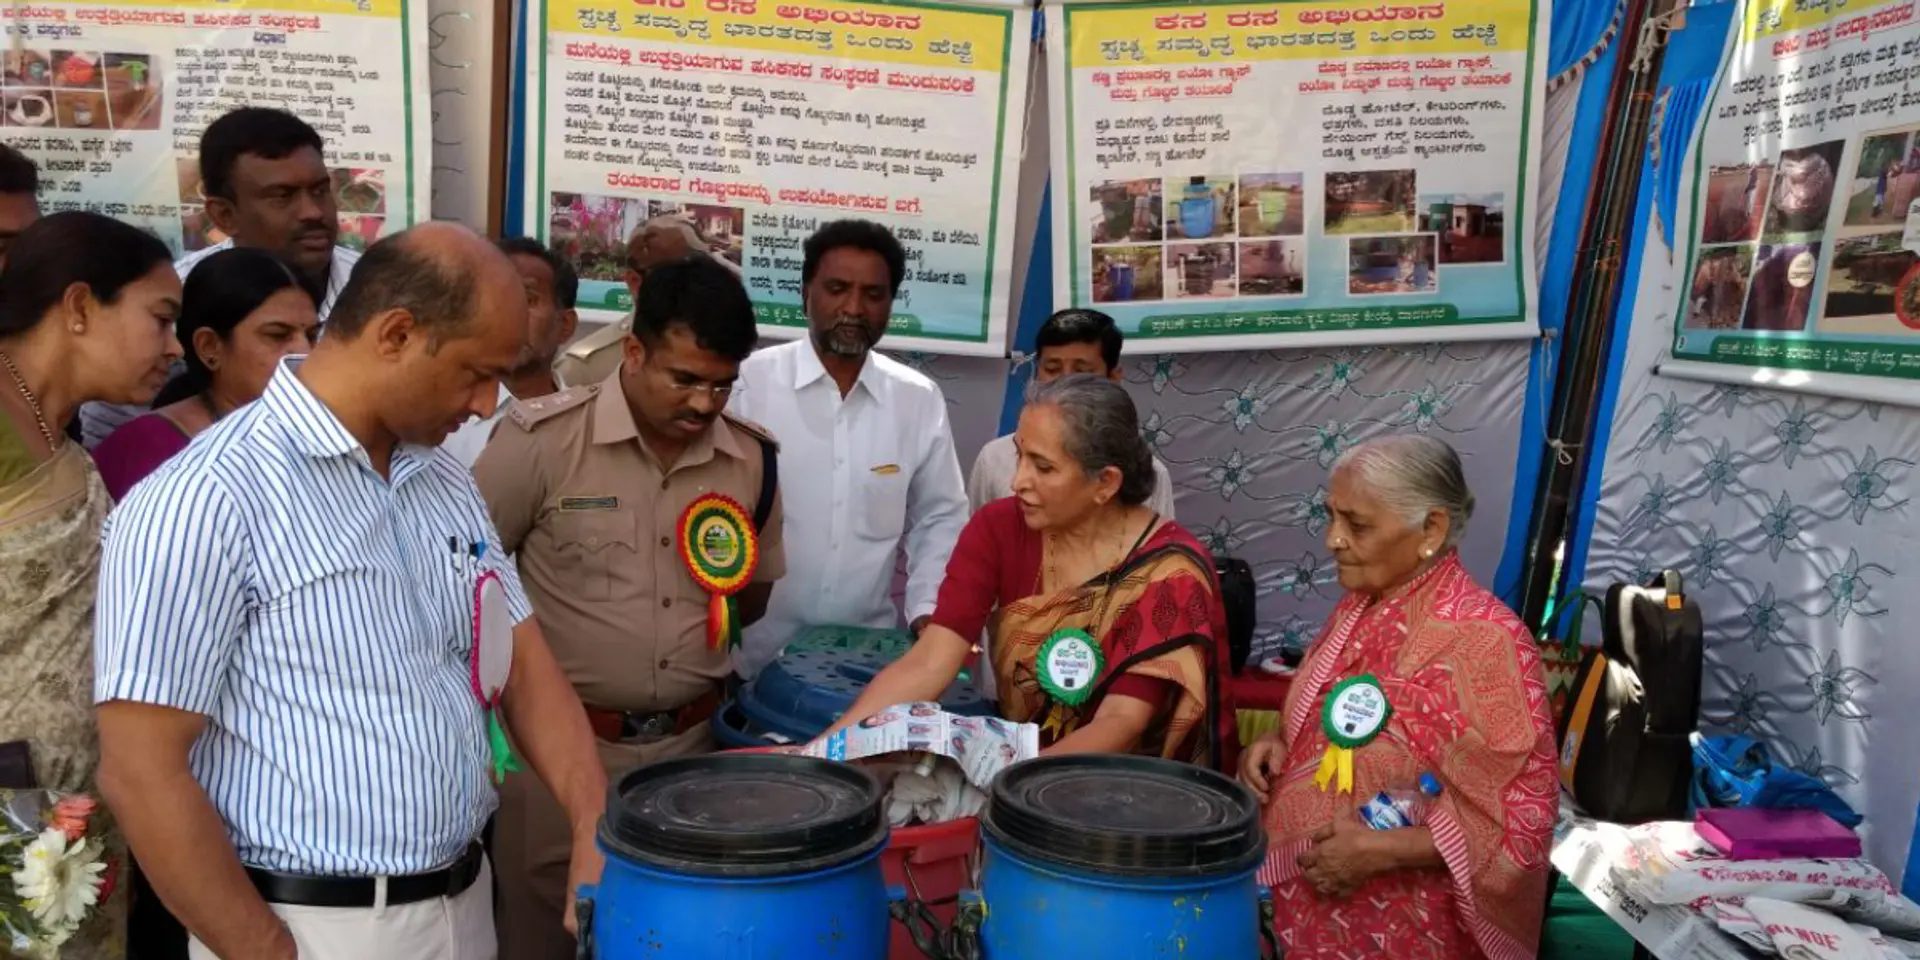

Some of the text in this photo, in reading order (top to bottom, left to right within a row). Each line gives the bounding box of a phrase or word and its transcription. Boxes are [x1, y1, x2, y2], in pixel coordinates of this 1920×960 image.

[776, 4, 921, 30] ಅಭಿಯಾನ
[1155, 3, 1445, 31] ಕಸ ರಸ ಅಭಿಯಾನ
[846, 33, 913, 51] ಒಂದು
[928, 39, 973, 63] ಹೆಜ್ಜೆ
[1369, 27, 1436, 43] ಒಂದು
[1452, 23, 1498, 46] ಹೆಜ್ಜೆ
[565, 42, 975, 93] ಮನೆಯಲ್ಲಿ ಉತ್ಪತ್ತಿಯಾಗುವ ಹಸಿಕಸದ ಸಂಸ್ಕರಣೆ ಮುಂದುವರಿಕೆ
[608, 172, 681, 191] ತಯಾರಾದ
[689, 177, 771, 205] ಗೊಬ್ಬರವನ್ನು
[779, 186, 889, 209] ಉಪಯೋಗಿಸುವ
